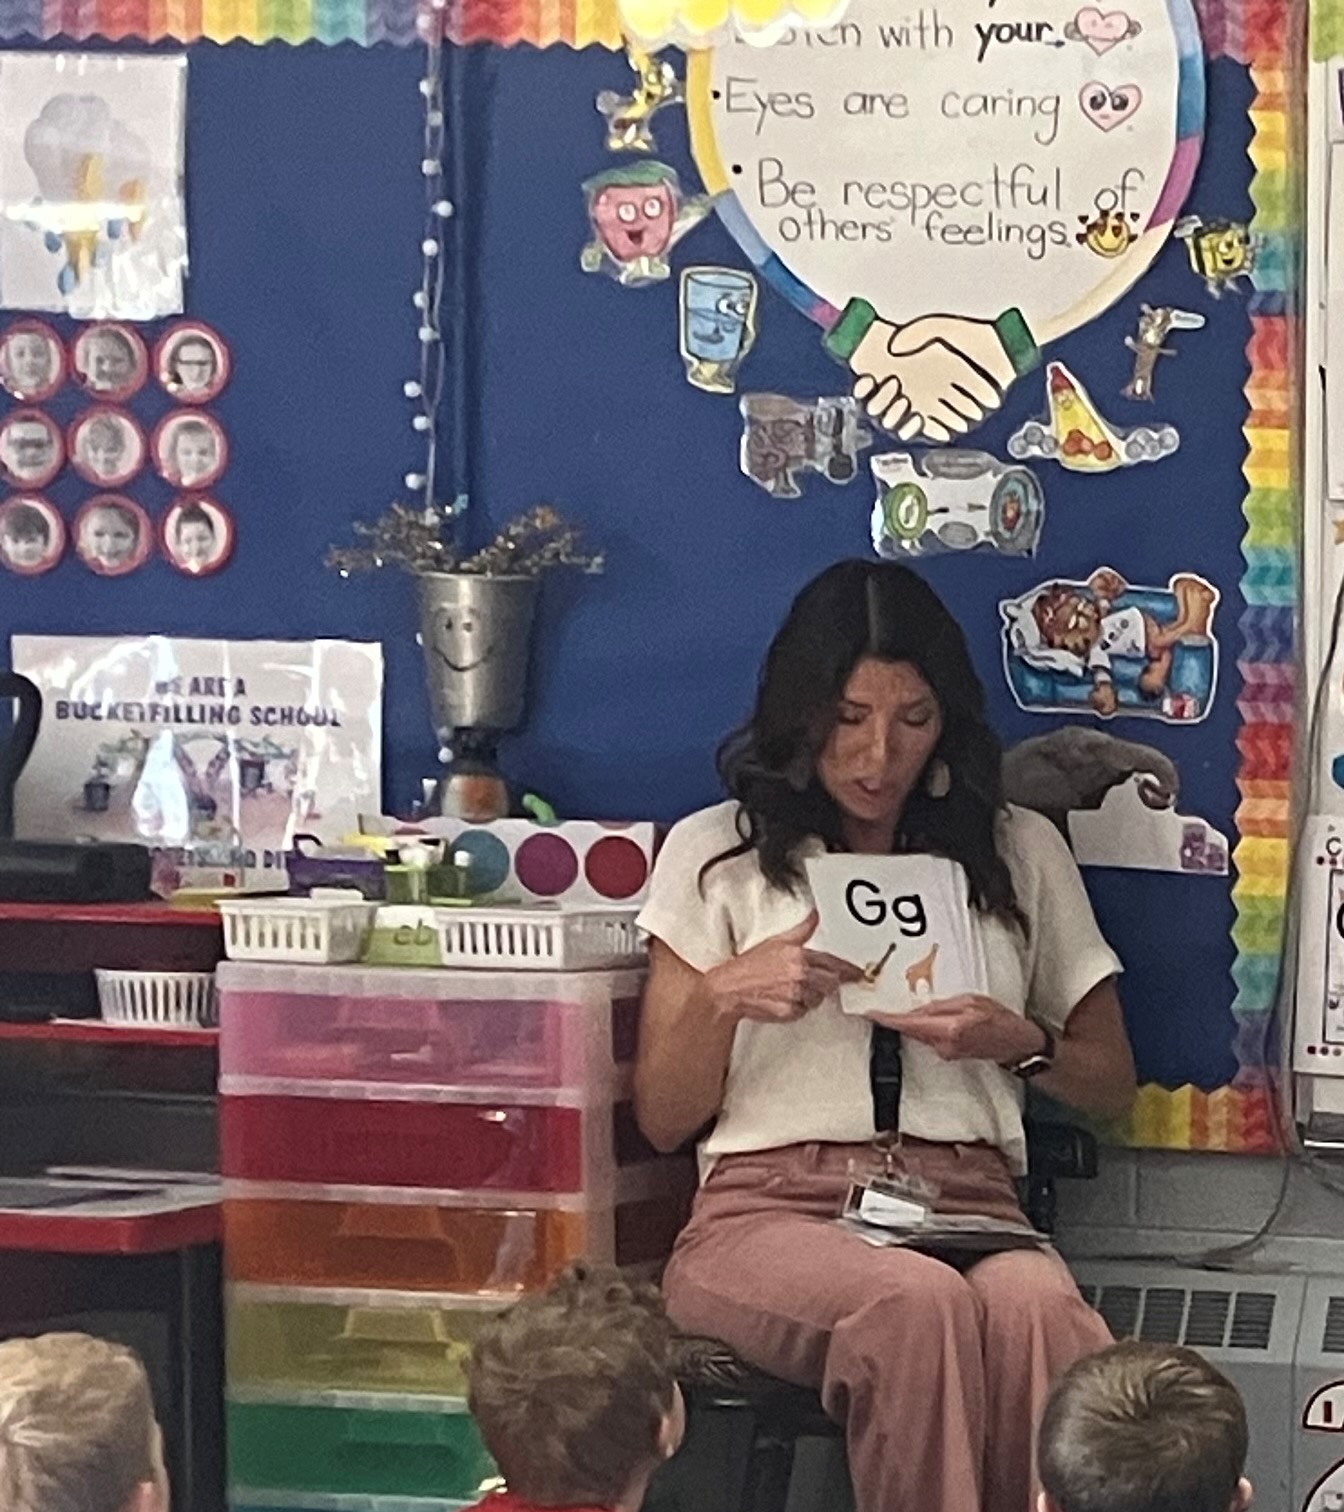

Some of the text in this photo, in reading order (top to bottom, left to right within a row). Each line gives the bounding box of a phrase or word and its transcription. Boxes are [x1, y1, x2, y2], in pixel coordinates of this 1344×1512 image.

[879, 10, 953, 50] with
[974, 20, 1053, 63] your
[724, 76, 1061, 146] Eyes are caring
[758, 157, 1145, 226] Be respectful of
[846, 879, 928, 937] Gg
